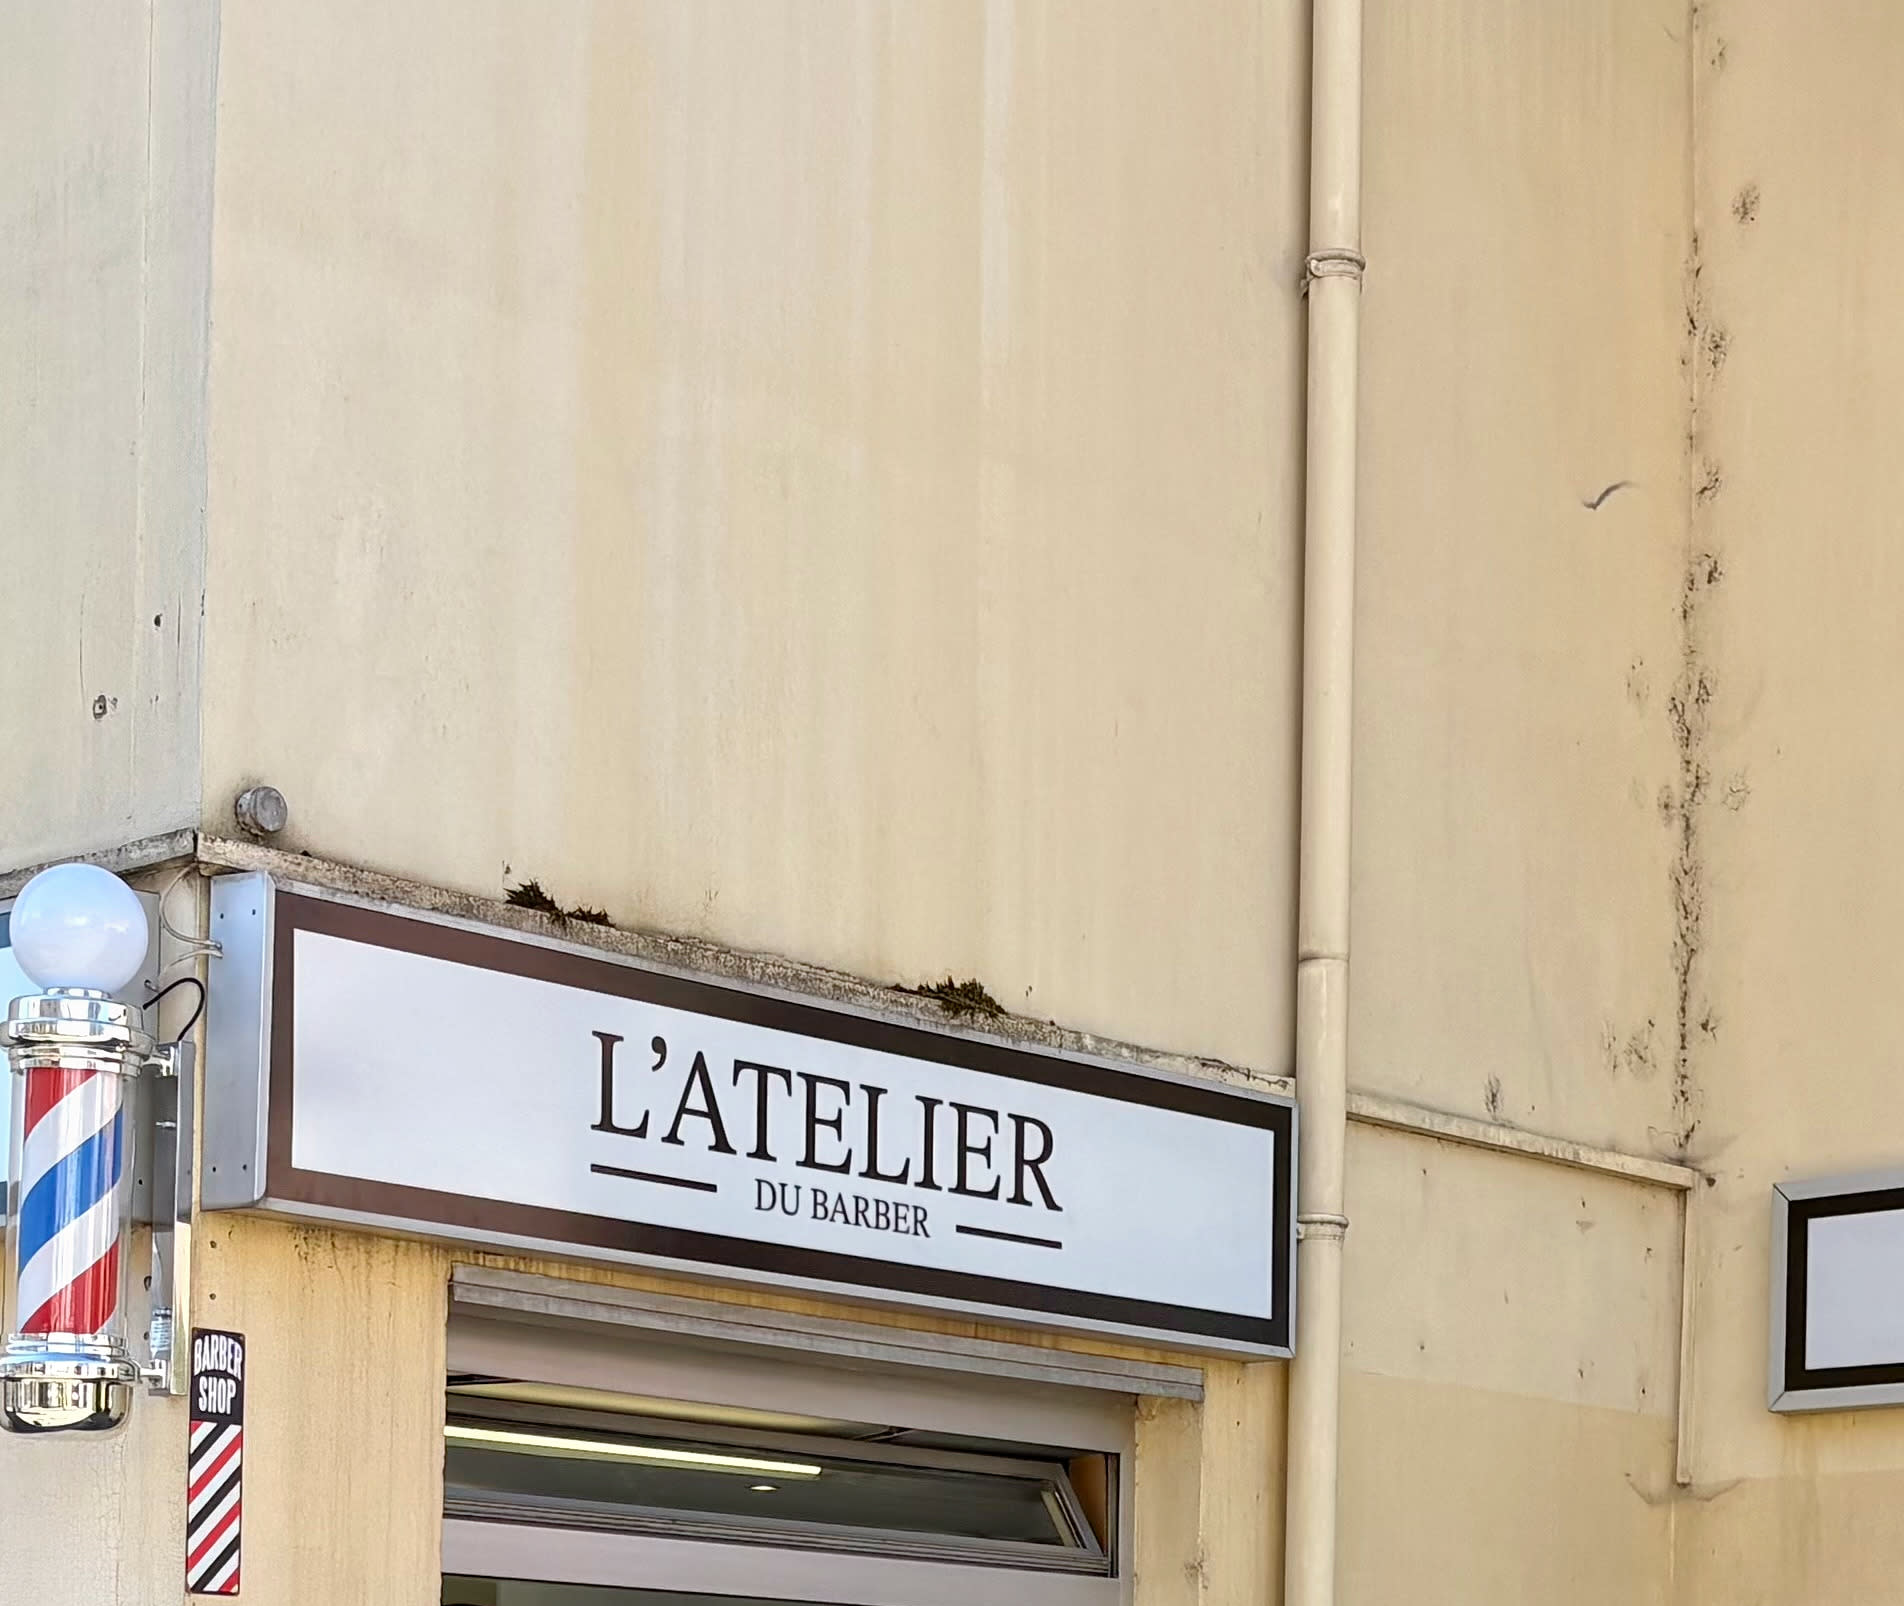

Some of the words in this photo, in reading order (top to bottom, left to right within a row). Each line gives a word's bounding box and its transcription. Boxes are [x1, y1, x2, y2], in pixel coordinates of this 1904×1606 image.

[590, 1030, 1063, 1211] L'ATELIER
[754, 1178, 801, 1216] DU
[809, 1188, 930, 1238] BARBER
[194, 1335, 242, 1381] BARBER
[199, 1376, 236, 1414] SHOP
